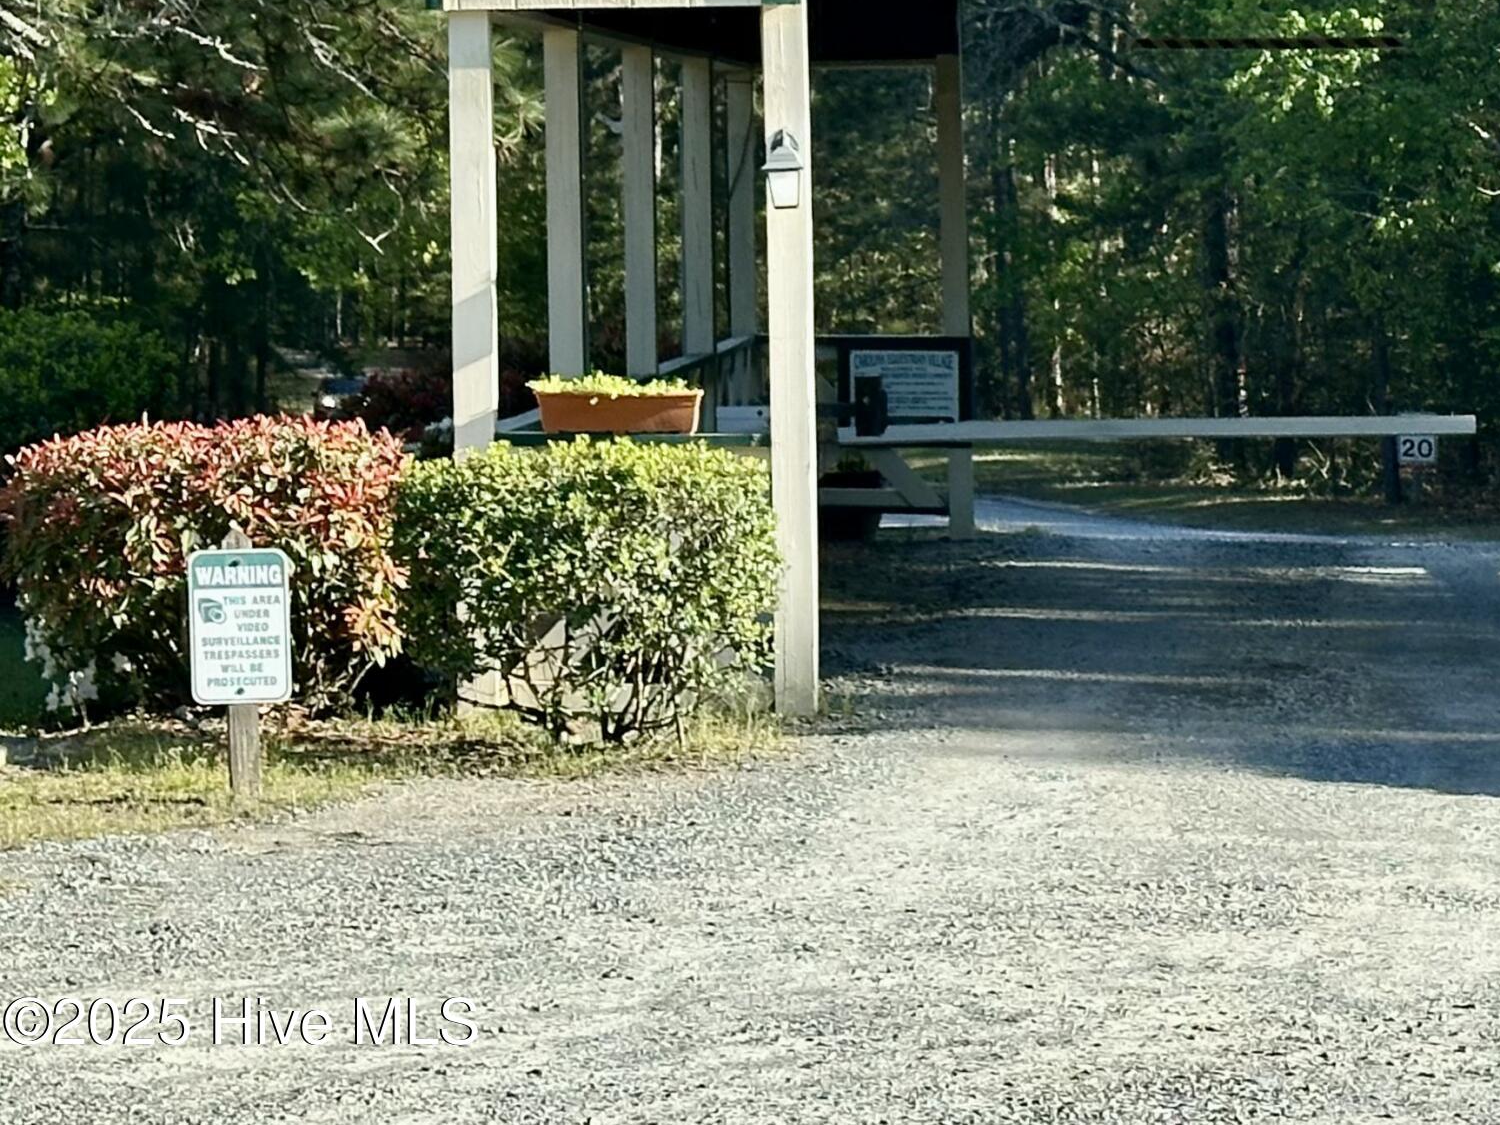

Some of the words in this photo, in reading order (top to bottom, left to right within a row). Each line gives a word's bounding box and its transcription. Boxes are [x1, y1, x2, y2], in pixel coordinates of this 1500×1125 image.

[1402, 438, 1433, 458] 20
[194, 563, 283, 586] WARNING
[223, 596, 246, 606] THIS
[252, 594, 281, 605] AREA
[233, 609, 270, 618] UNDER
[237, 622, 270, 632] VIDEO
[201, 635, 281, 647] SURVEILLANCE
[203, 648, 280, 660] TRESPASSERS
[220, 663, 245, 673] WILL
[250, 662, 263, 672] BE
[206, 675, 278, 688] PROSECUTED
